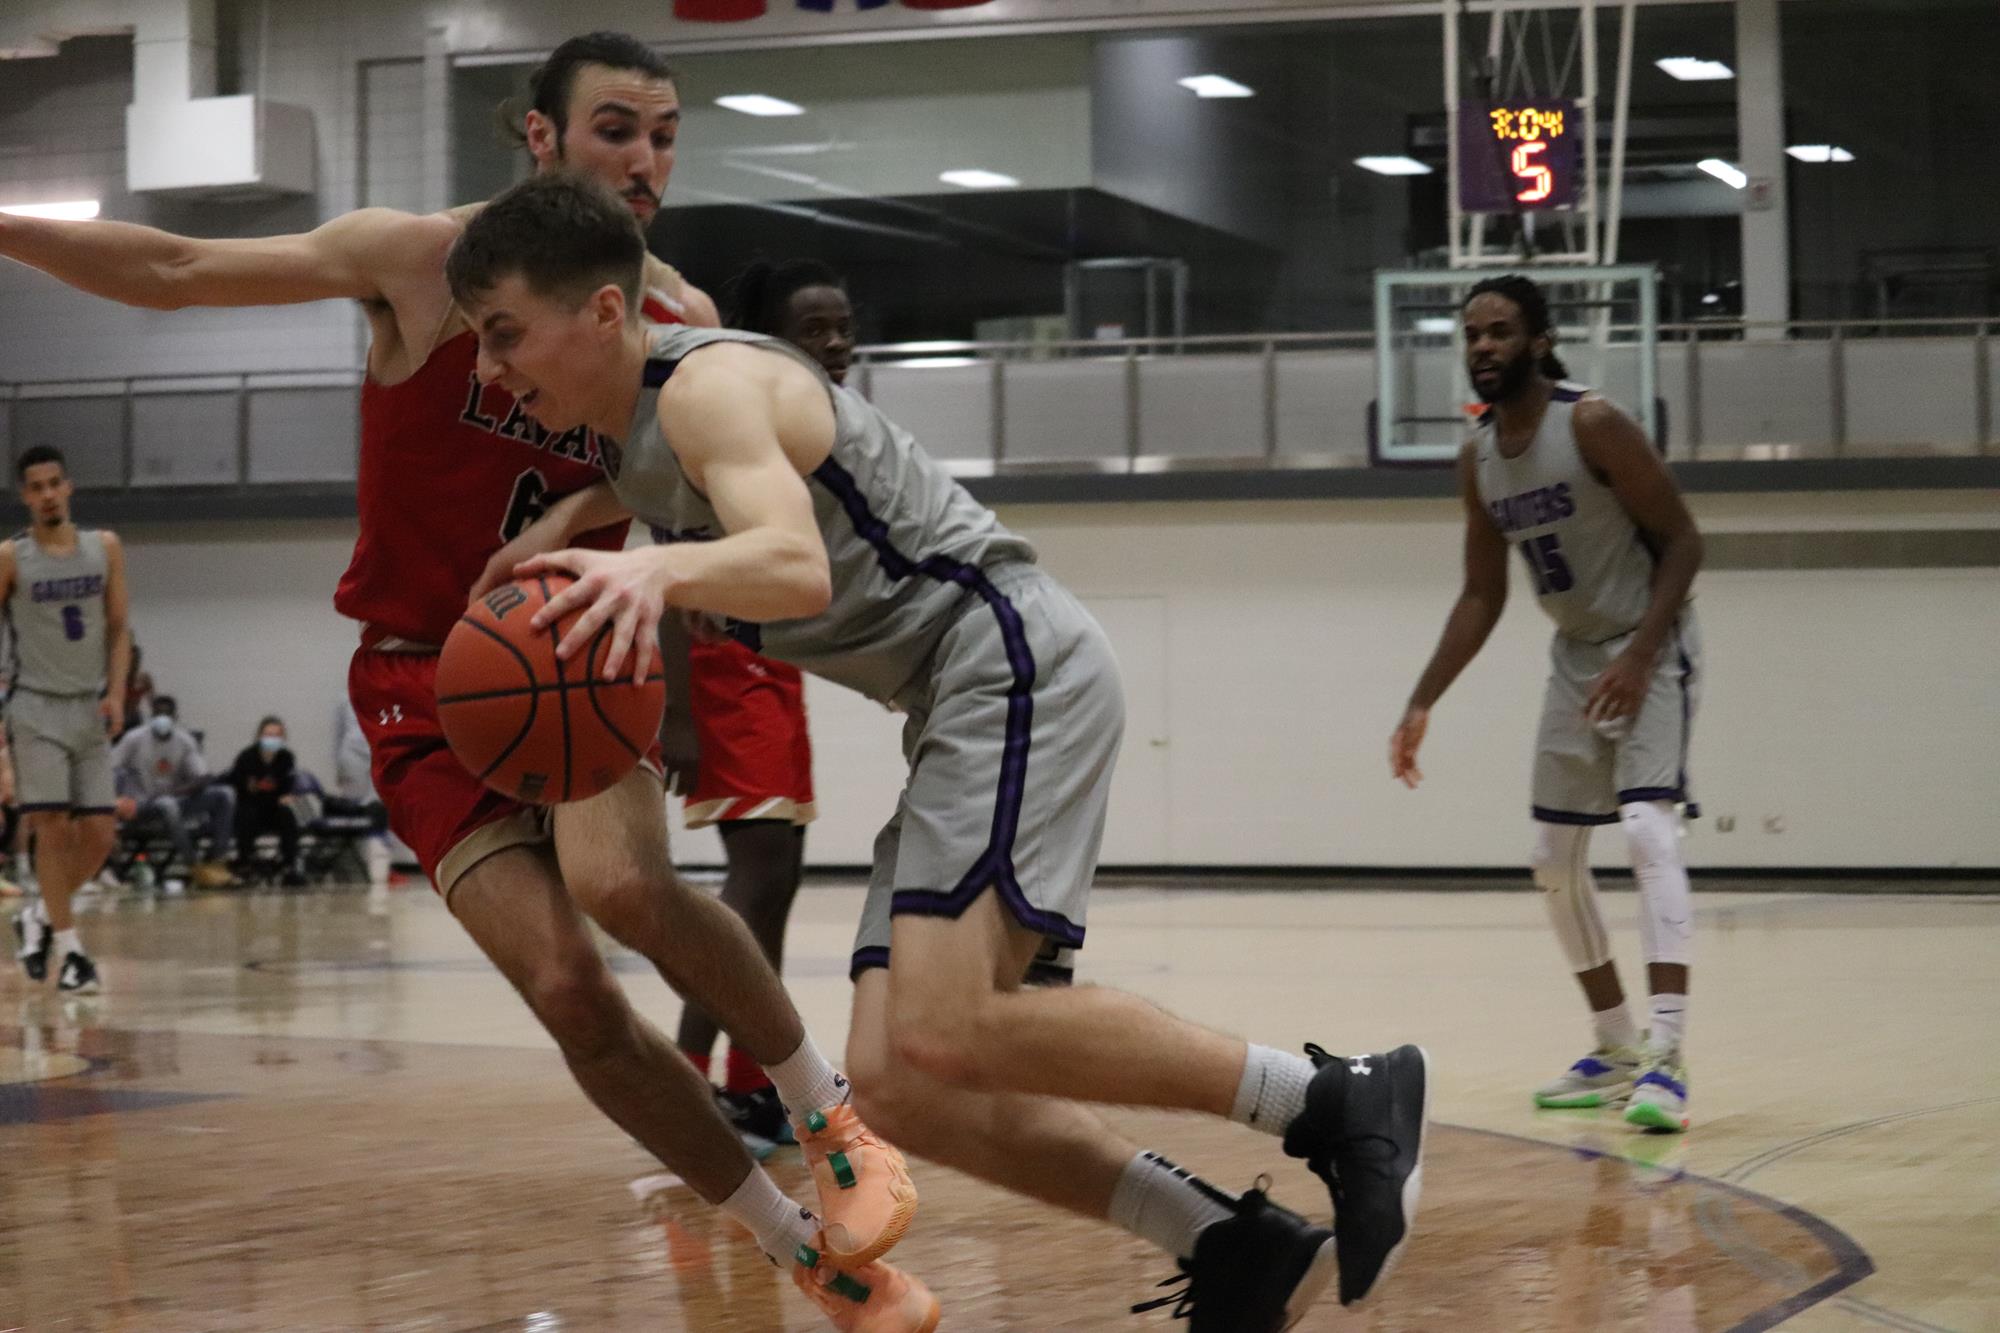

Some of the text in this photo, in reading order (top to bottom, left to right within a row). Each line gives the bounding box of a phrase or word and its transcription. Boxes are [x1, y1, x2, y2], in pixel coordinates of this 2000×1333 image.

[1512, 142, 1552, 202] 5
[459, 369, 604, 469] LAVA
[1521, 533, 1575, 595] 15
[62, 605, 86, 641] 6
